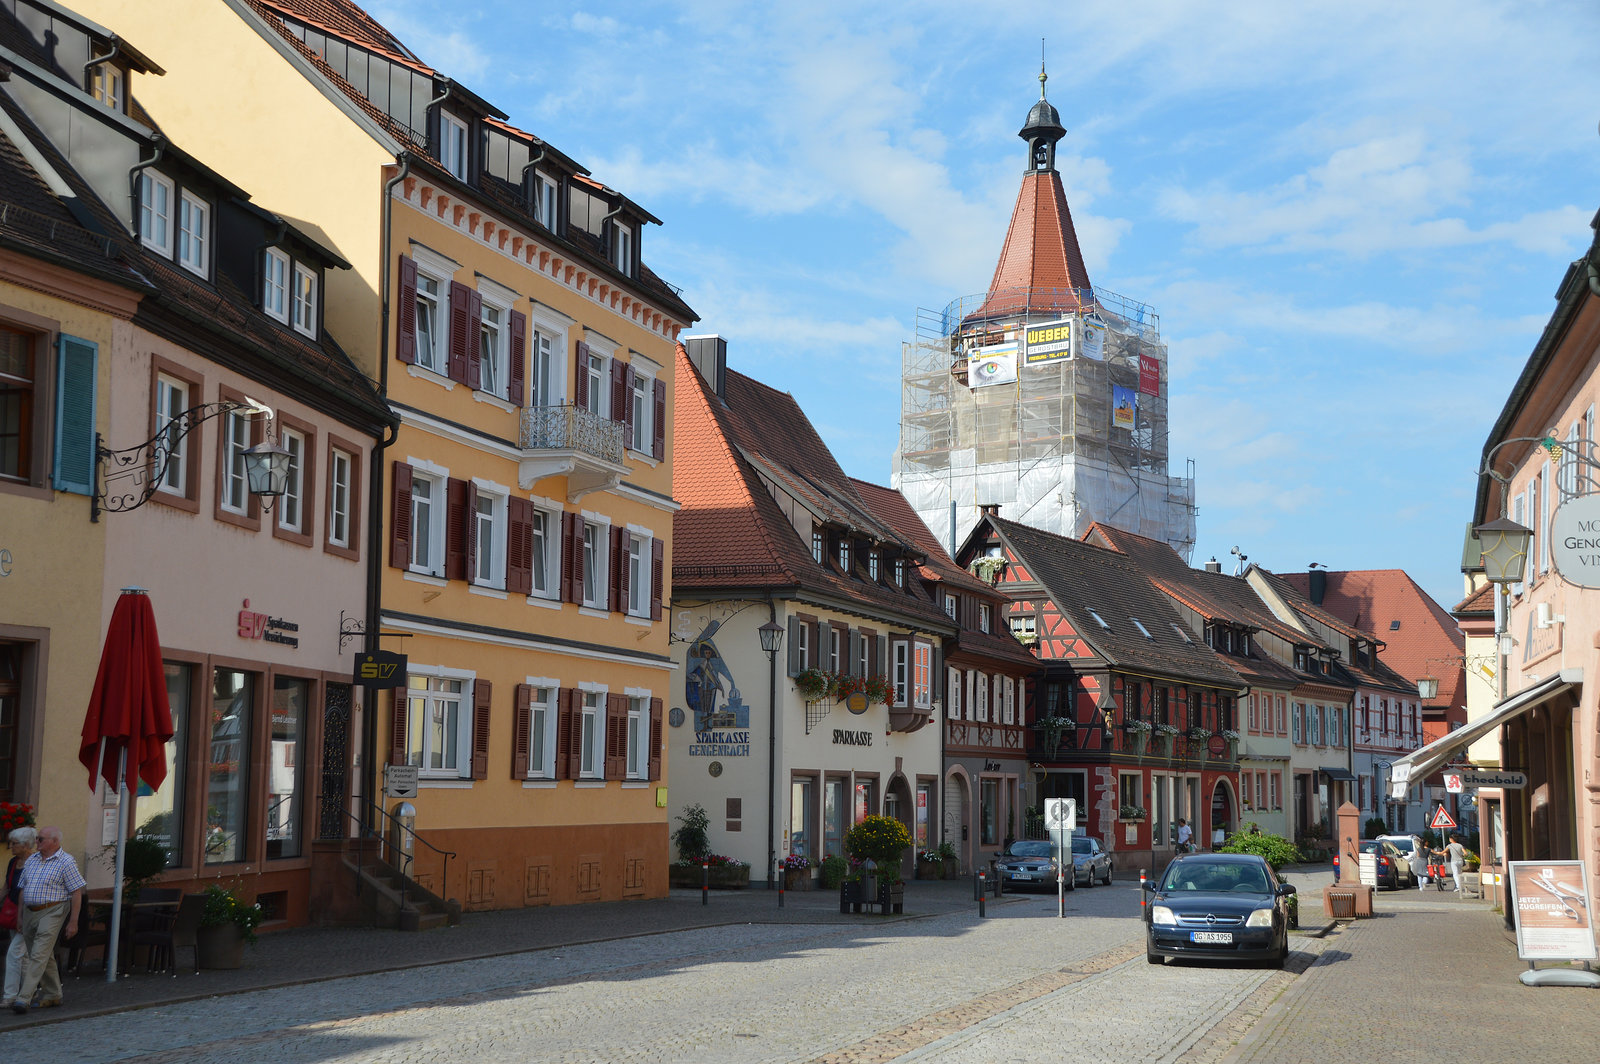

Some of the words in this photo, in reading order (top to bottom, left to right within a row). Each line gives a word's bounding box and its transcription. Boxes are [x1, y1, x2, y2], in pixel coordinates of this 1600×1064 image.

[1027, 326, 1070, 344] WEBER
[1579, 554, 1600, 566] VI
[695, 732, 750, 744] SPARKASSE
[832, 728, 872, 746] SPARKASSE
[689, 744, 750, 756] GENGENBACH
[1463, 774, 1523, 785] theobald
